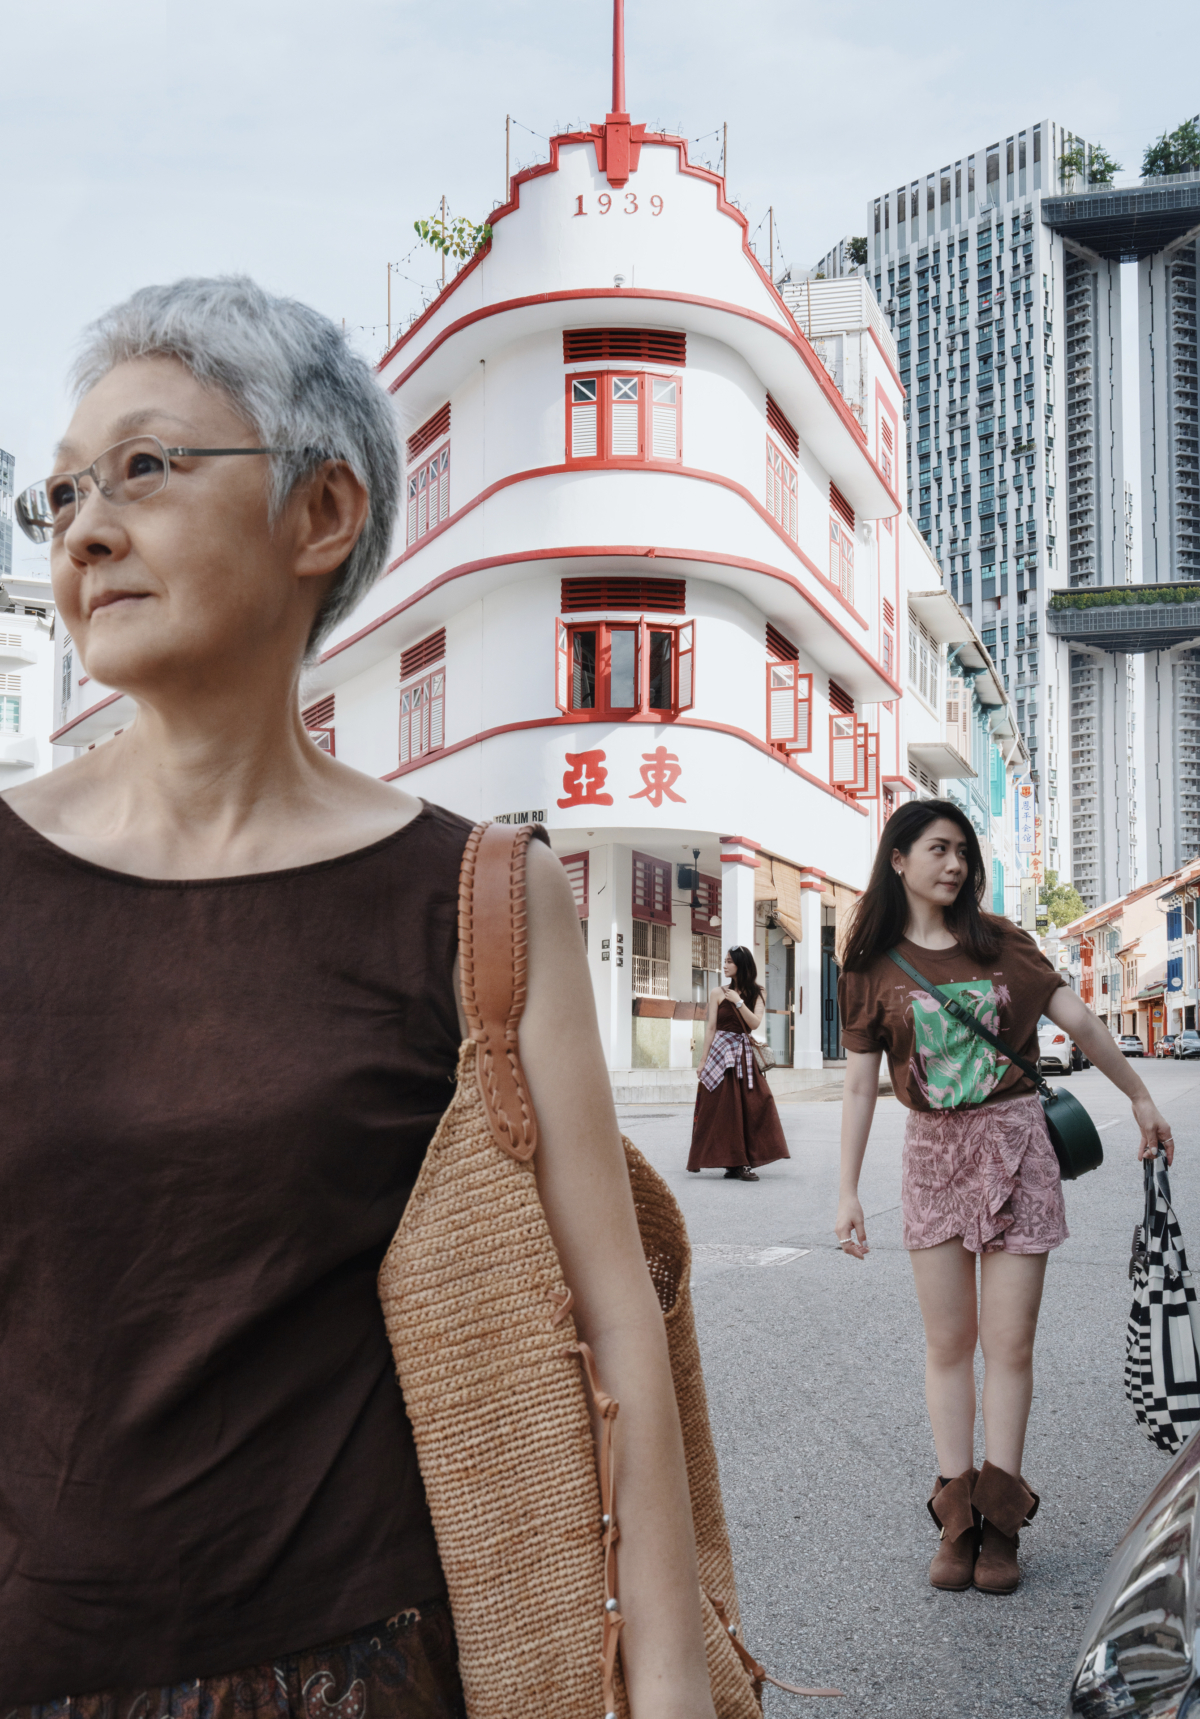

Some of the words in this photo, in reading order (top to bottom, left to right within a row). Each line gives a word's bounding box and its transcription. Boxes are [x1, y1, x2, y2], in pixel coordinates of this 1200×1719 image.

[573, 192, 664, 216] 1939
[513, 811, 529, 824] LIM
[532, 810, 544, 822] RD
